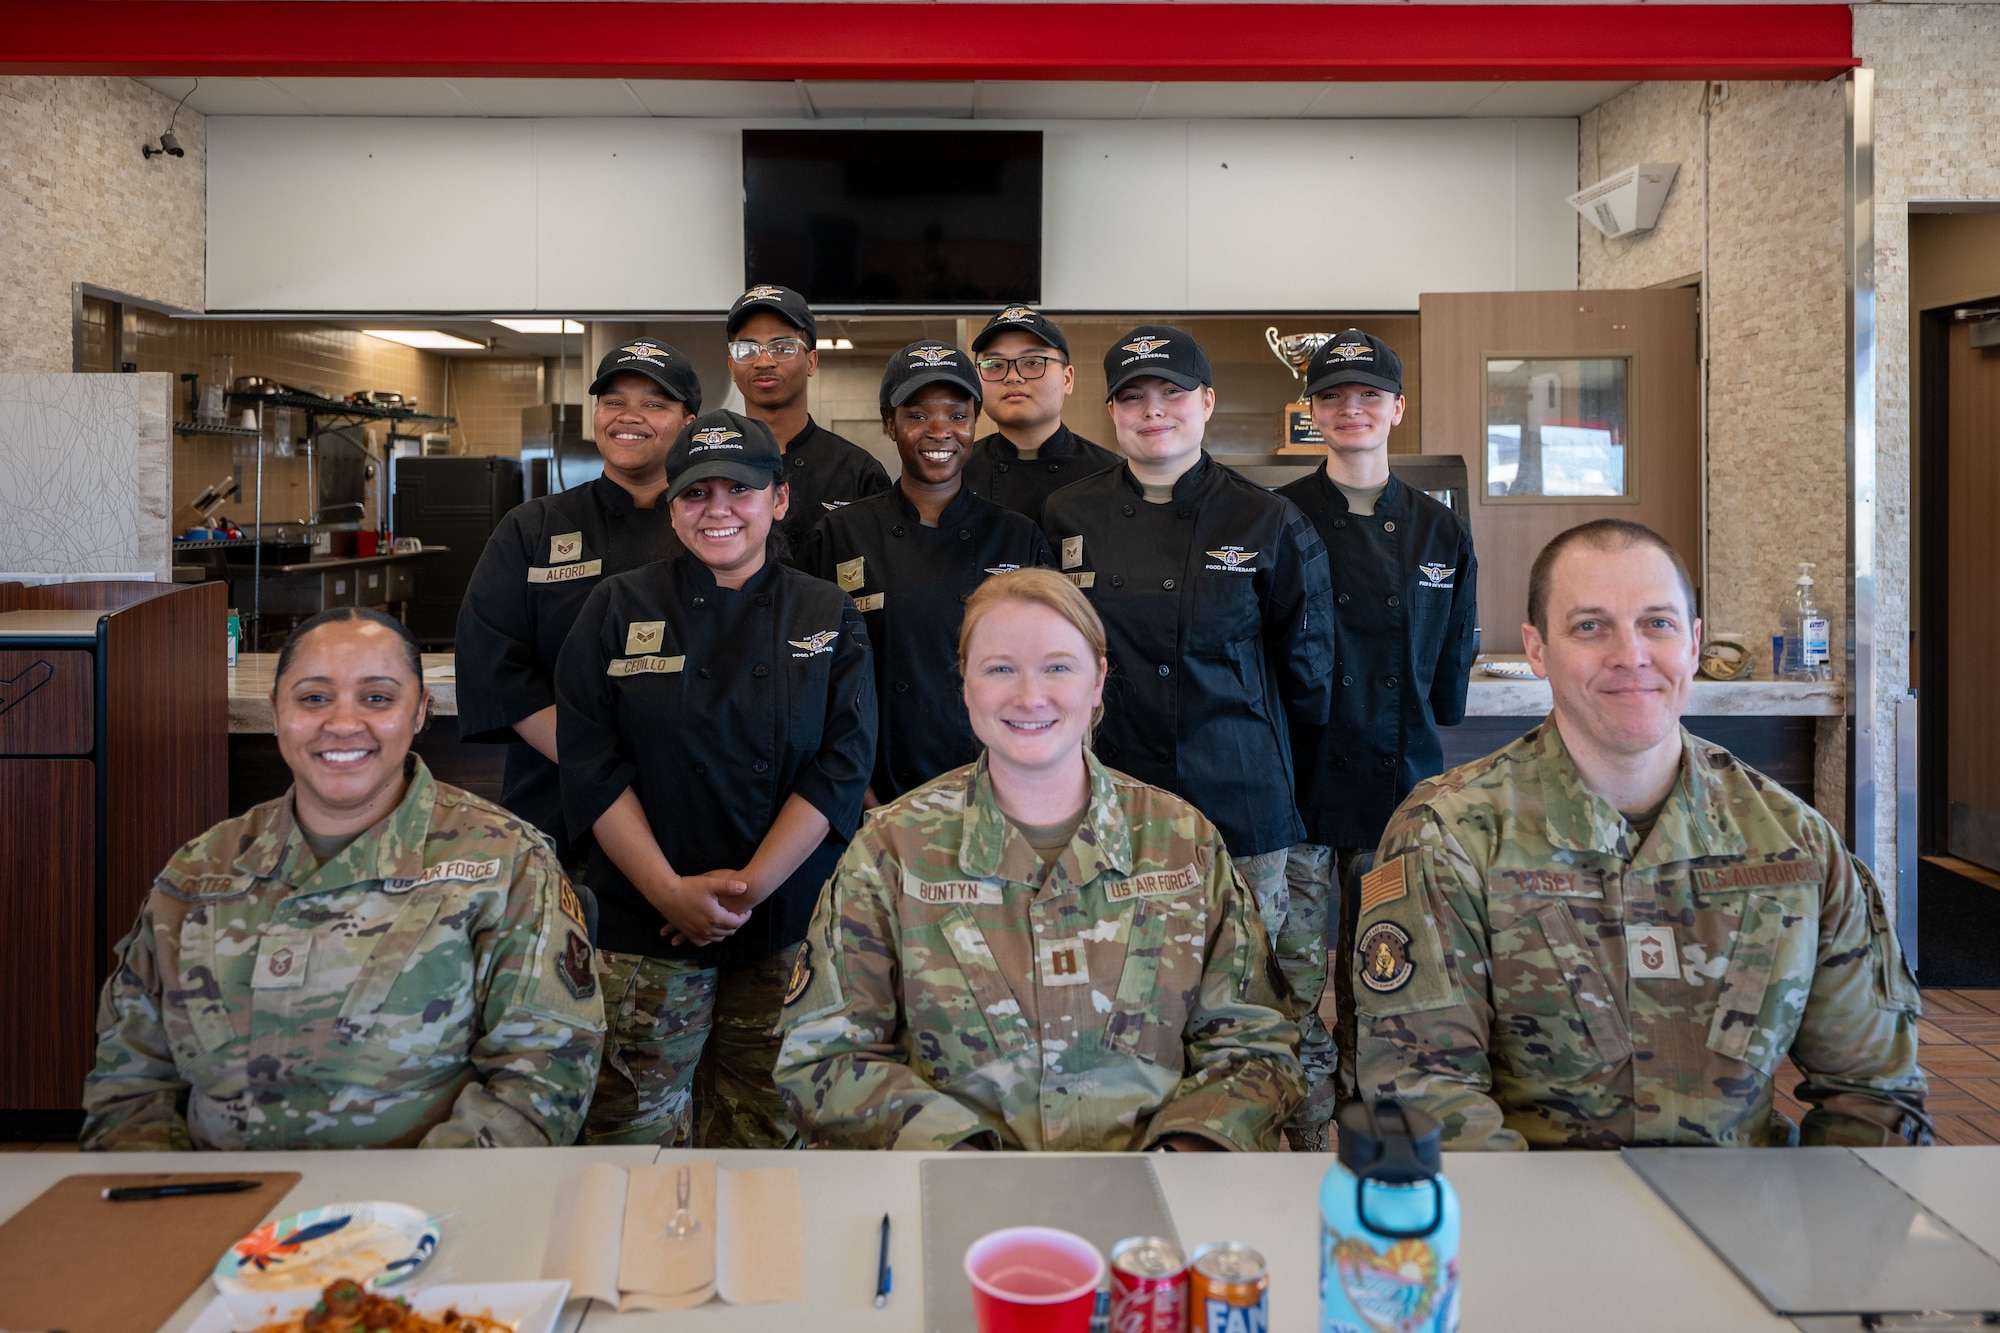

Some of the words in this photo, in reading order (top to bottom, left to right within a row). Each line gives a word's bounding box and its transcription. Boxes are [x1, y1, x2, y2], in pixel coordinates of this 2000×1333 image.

[1122, 357, 1134, 366] FOOD
[547, 565, 585, 580] ALFORD
[625, 659, 666, 673] CEDILLO
[418, 866, 441, 882] AIR
[446, 862, 494, 878] FORCE
[1136, 876, 1157, 893] AIR
[1157, 869, 1194, 891] FORCE
[1733, 867, 1762, 886] AIR
[1763, 861, 1820, 884] FORCE
[920, 882, 977, 901] BUNTYN
[1519, 872, 1576, 892] CASEY
